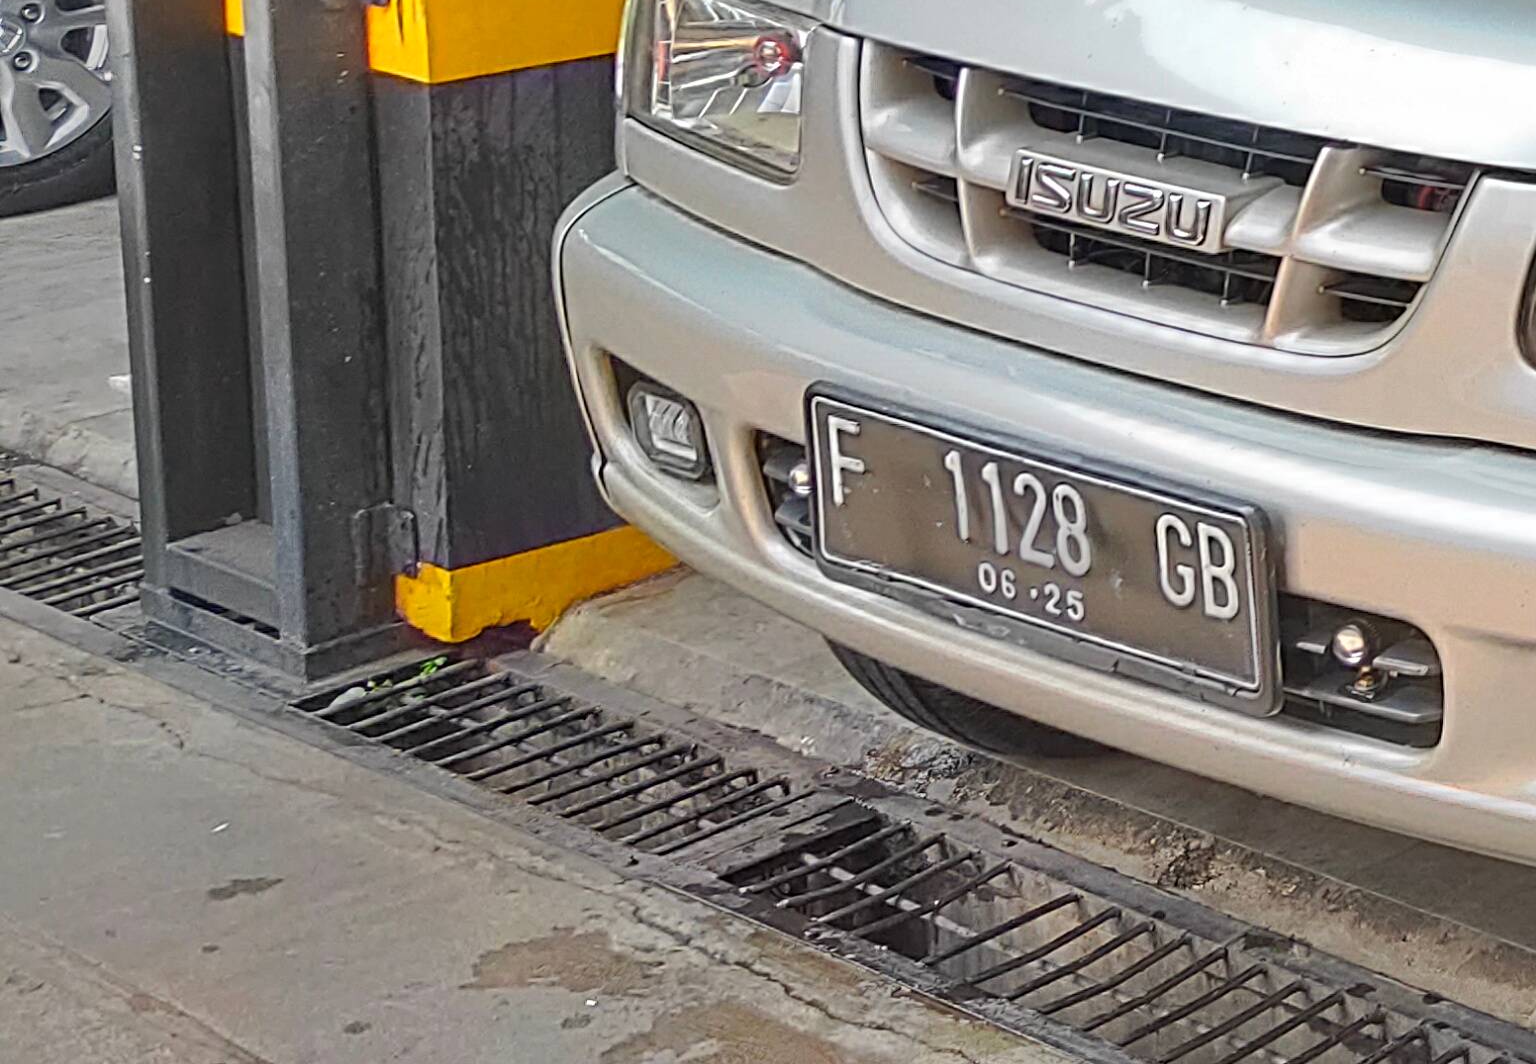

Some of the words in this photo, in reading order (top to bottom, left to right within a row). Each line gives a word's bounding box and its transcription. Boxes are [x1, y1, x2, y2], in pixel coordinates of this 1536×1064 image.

[1015, 157, 1211, 246] ISUZU
[827, 415, 866, 505] F
[943, 449, 1093, 577] 1128
[1155, 513, 1240, 620] GB
